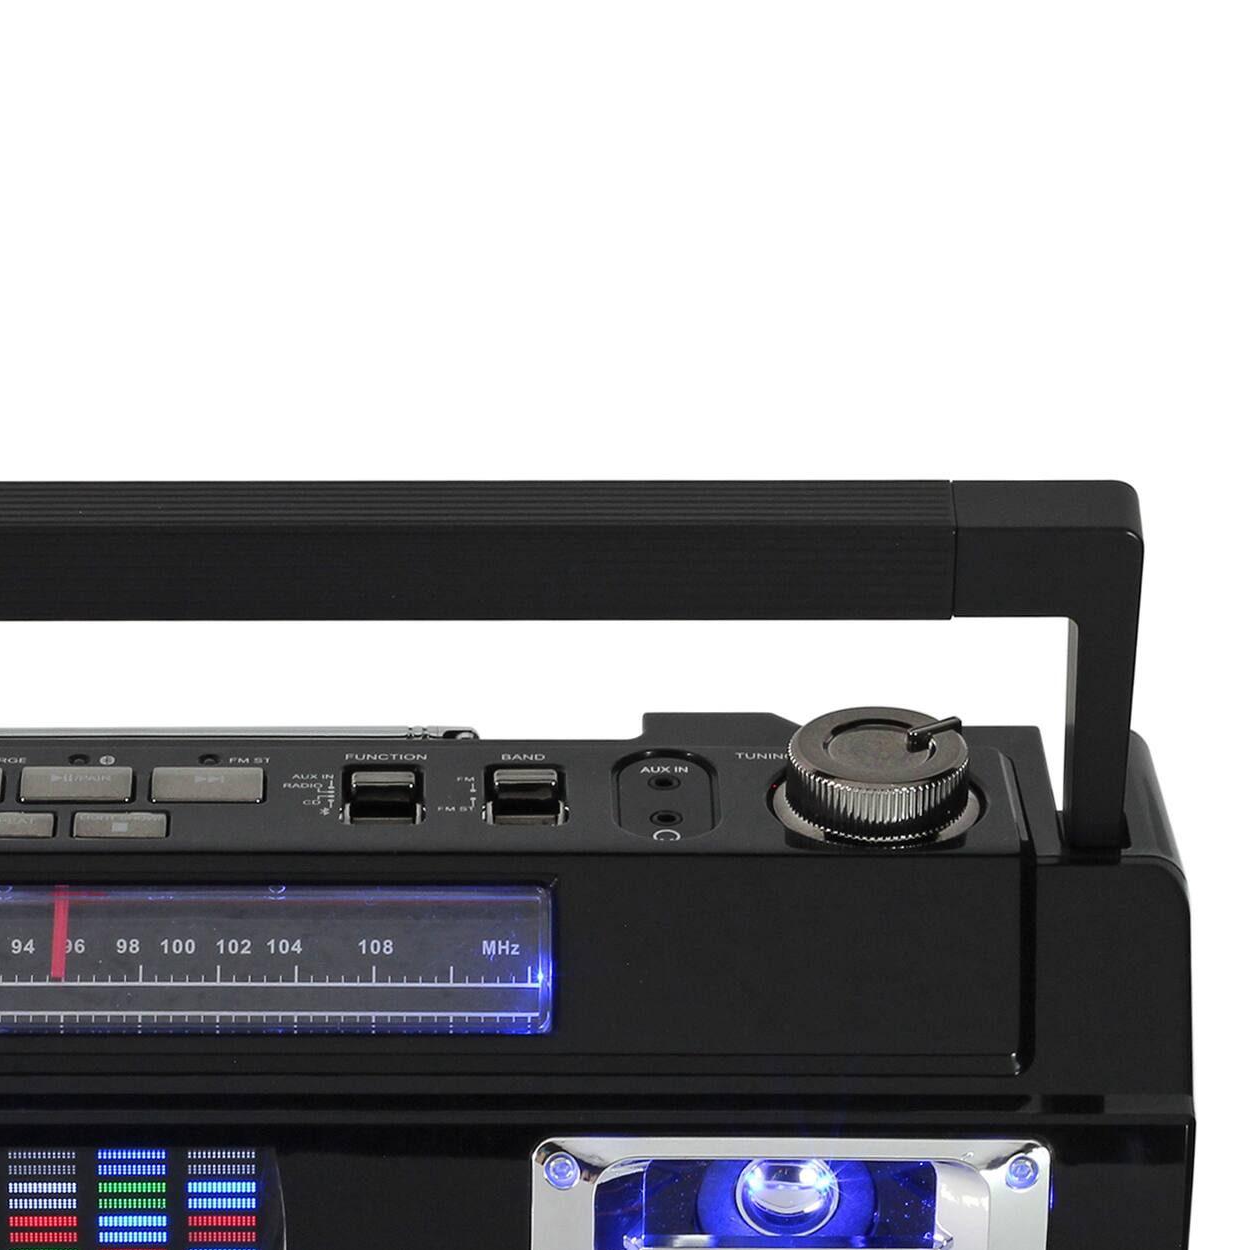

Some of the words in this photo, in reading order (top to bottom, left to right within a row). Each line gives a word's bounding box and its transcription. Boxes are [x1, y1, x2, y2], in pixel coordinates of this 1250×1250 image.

[229, 756, 250, 764] FM
[253, 756, 271, 764] ST
[344, 752, 428, 761] FUNCTION
[501, 752, 546, 761] BAND
[640, 765, 671, 774] AUX
[674, 765, 688, 774] IN
[11, 939, 36, 955] 94
[116, 939, 141, 955] 98
[160, 939, 196, 955] 100
[216, 939, 252, 955] 102
[266, 939, 303, 955] 104
[358, 939, 394, 955] 108
[482, 939, 520, 956] MHz
